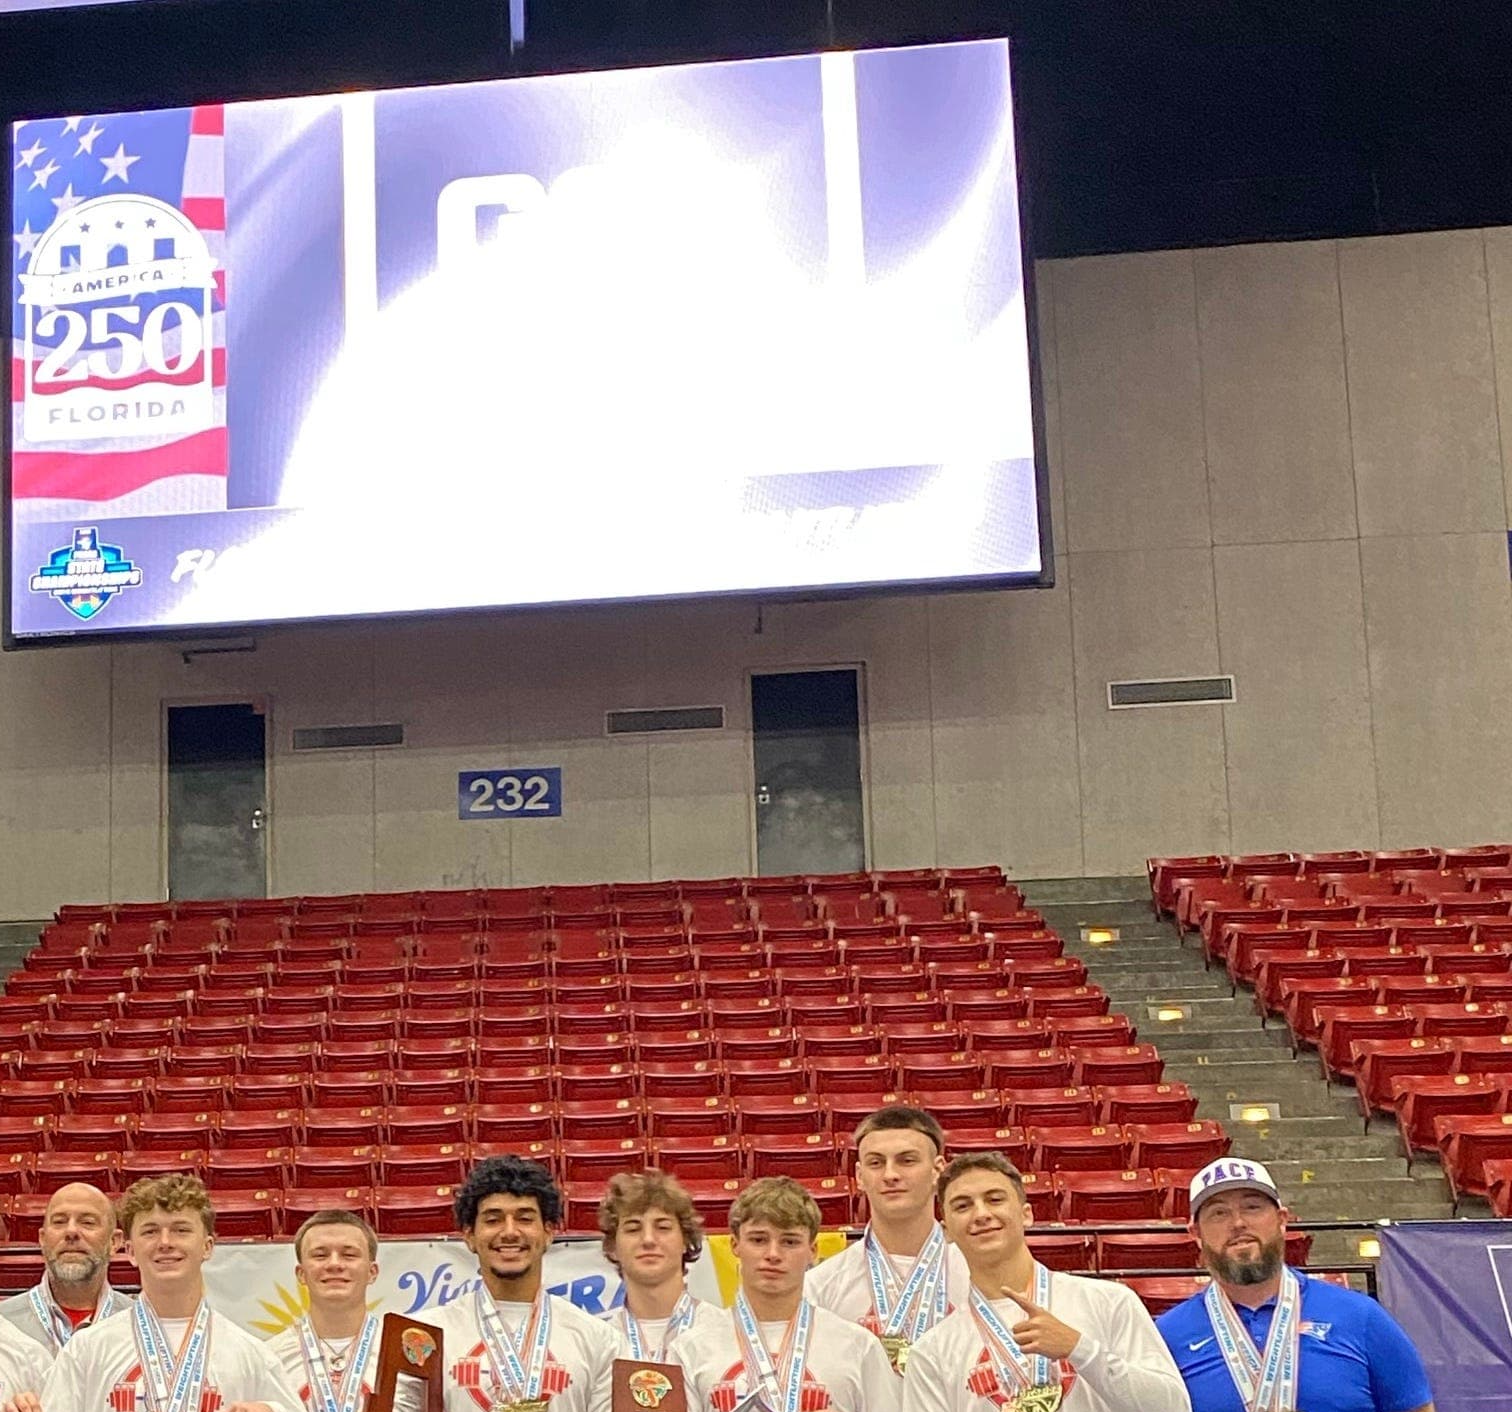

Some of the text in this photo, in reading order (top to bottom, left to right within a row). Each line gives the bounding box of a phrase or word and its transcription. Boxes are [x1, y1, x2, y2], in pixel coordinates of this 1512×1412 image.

[35, 302, 202, 383] 250
[48, 399, 187, 425] FLORIDA
[469, 775, 550, 812] 232
[1202, 1163, 1255, 1187] PACE
[890, 1265, 925, 1328] WEIGHTLIFTING
[976, 1304, 1022, 1360] WEIGHTLIFTING
[1265, 1305, 1290, 1382] WEIGHTLIFTING
[174, 1332, 201, 1400] WEIGHTLIFTING
